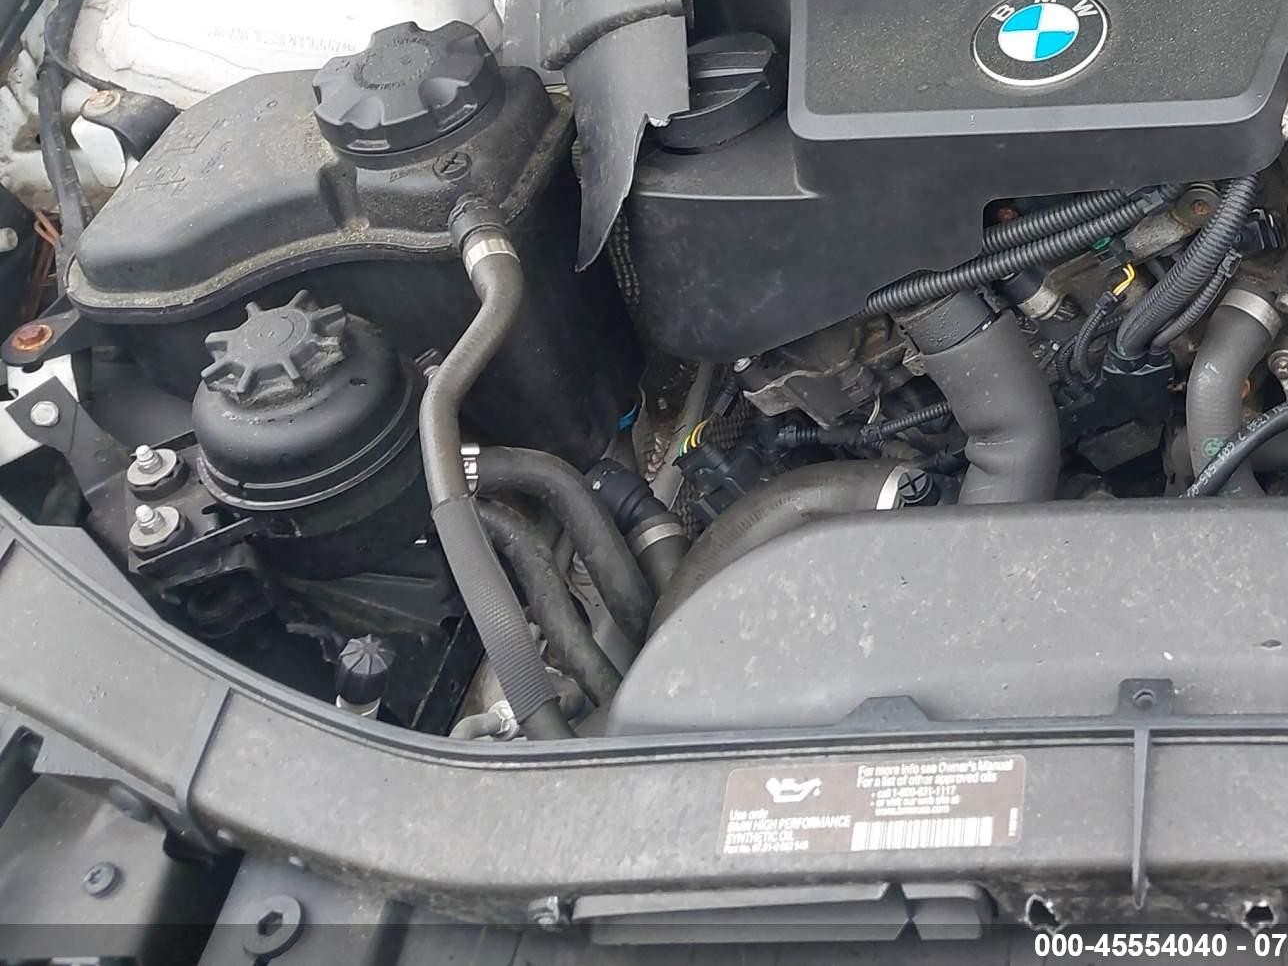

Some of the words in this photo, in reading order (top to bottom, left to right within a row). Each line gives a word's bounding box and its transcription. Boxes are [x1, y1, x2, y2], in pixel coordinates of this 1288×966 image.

[858, 765, 874, 777] For
[875, 766, 900, 776] more
[901, 764, 919, 775] info
[920, 763, 937, 774] see
[938, 761, 977, 773] Owner's
[977, 759, 1014, 772] Manual
[857, 776, 873, 788] For
[882, 775, 897, 787] list
[908, 774, 934, 785] other
[934, 772, 979, 785] approved
[980, 771, 998, 783] oils
[729, 809, 748, 821] Use
[748, 808, 769, 821] only
[753, 818, 778, 831] HIGH
[778, 814, 852, 830] PERFORMANCE
[725, 831, 778, 845] SYNTHETIC
